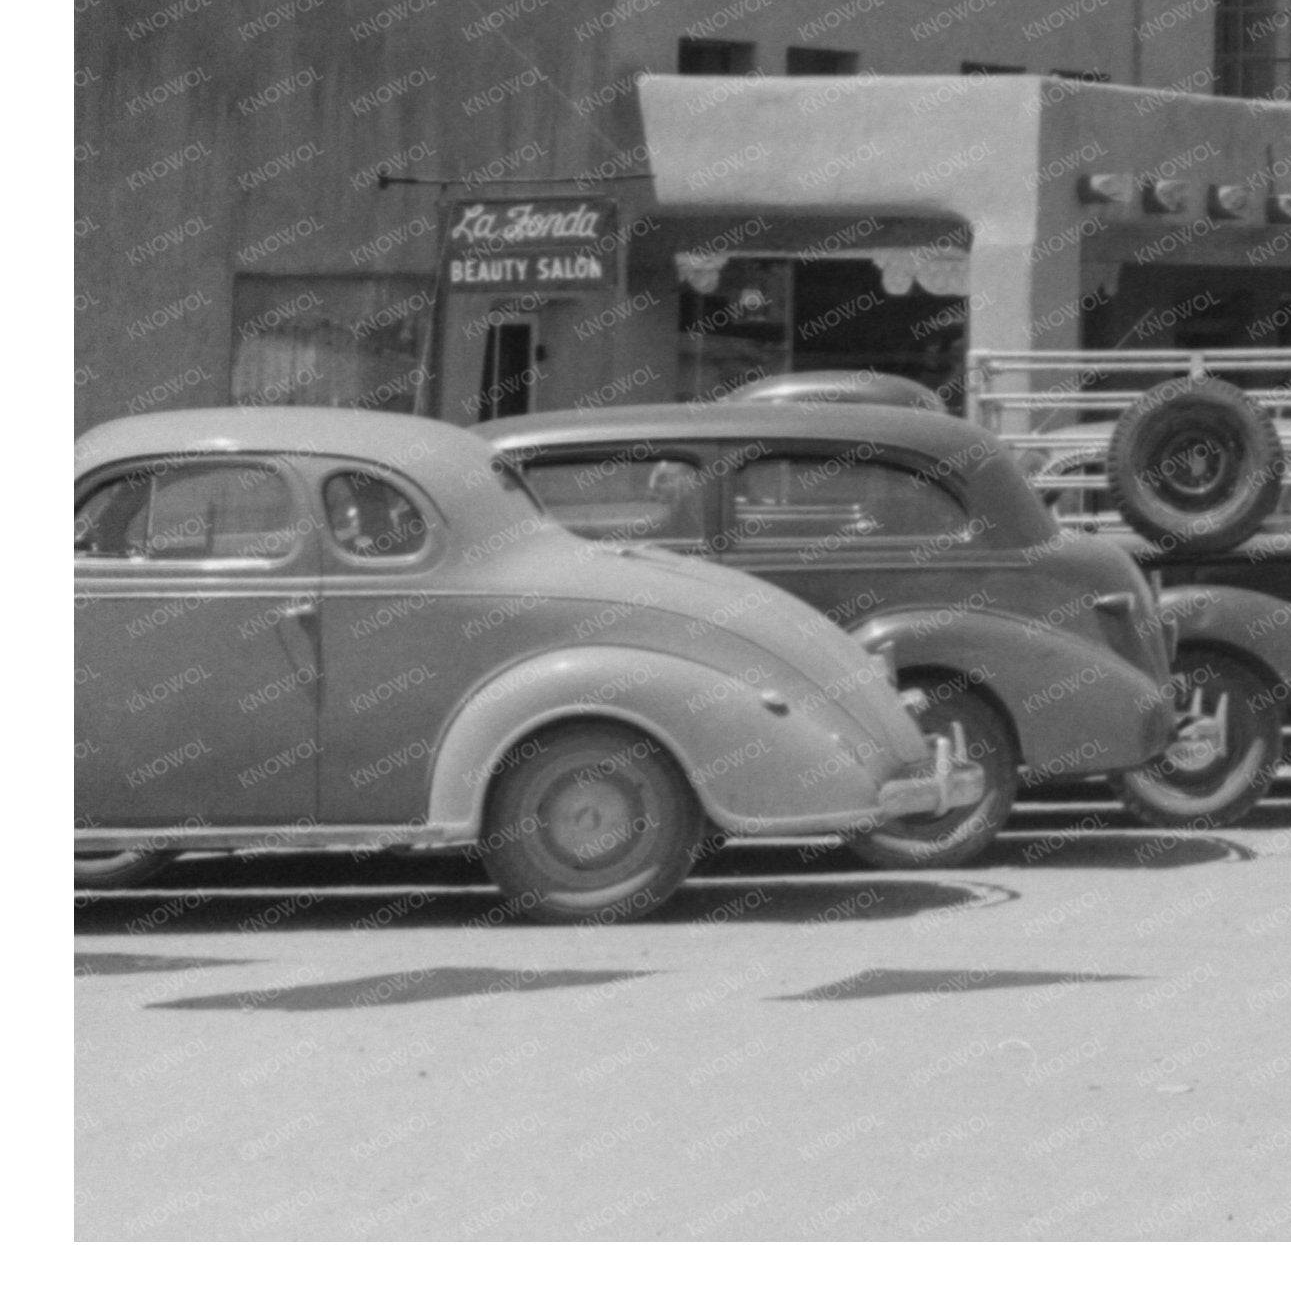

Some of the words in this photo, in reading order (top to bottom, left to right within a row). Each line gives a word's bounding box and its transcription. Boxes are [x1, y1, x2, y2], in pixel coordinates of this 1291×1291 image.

[452, 204, 500, 243] La
[503, 203, 600, 242] Fonda
[451, 259, 529, 282] BEAUTY
[537, 257, 602, 280] SALON
